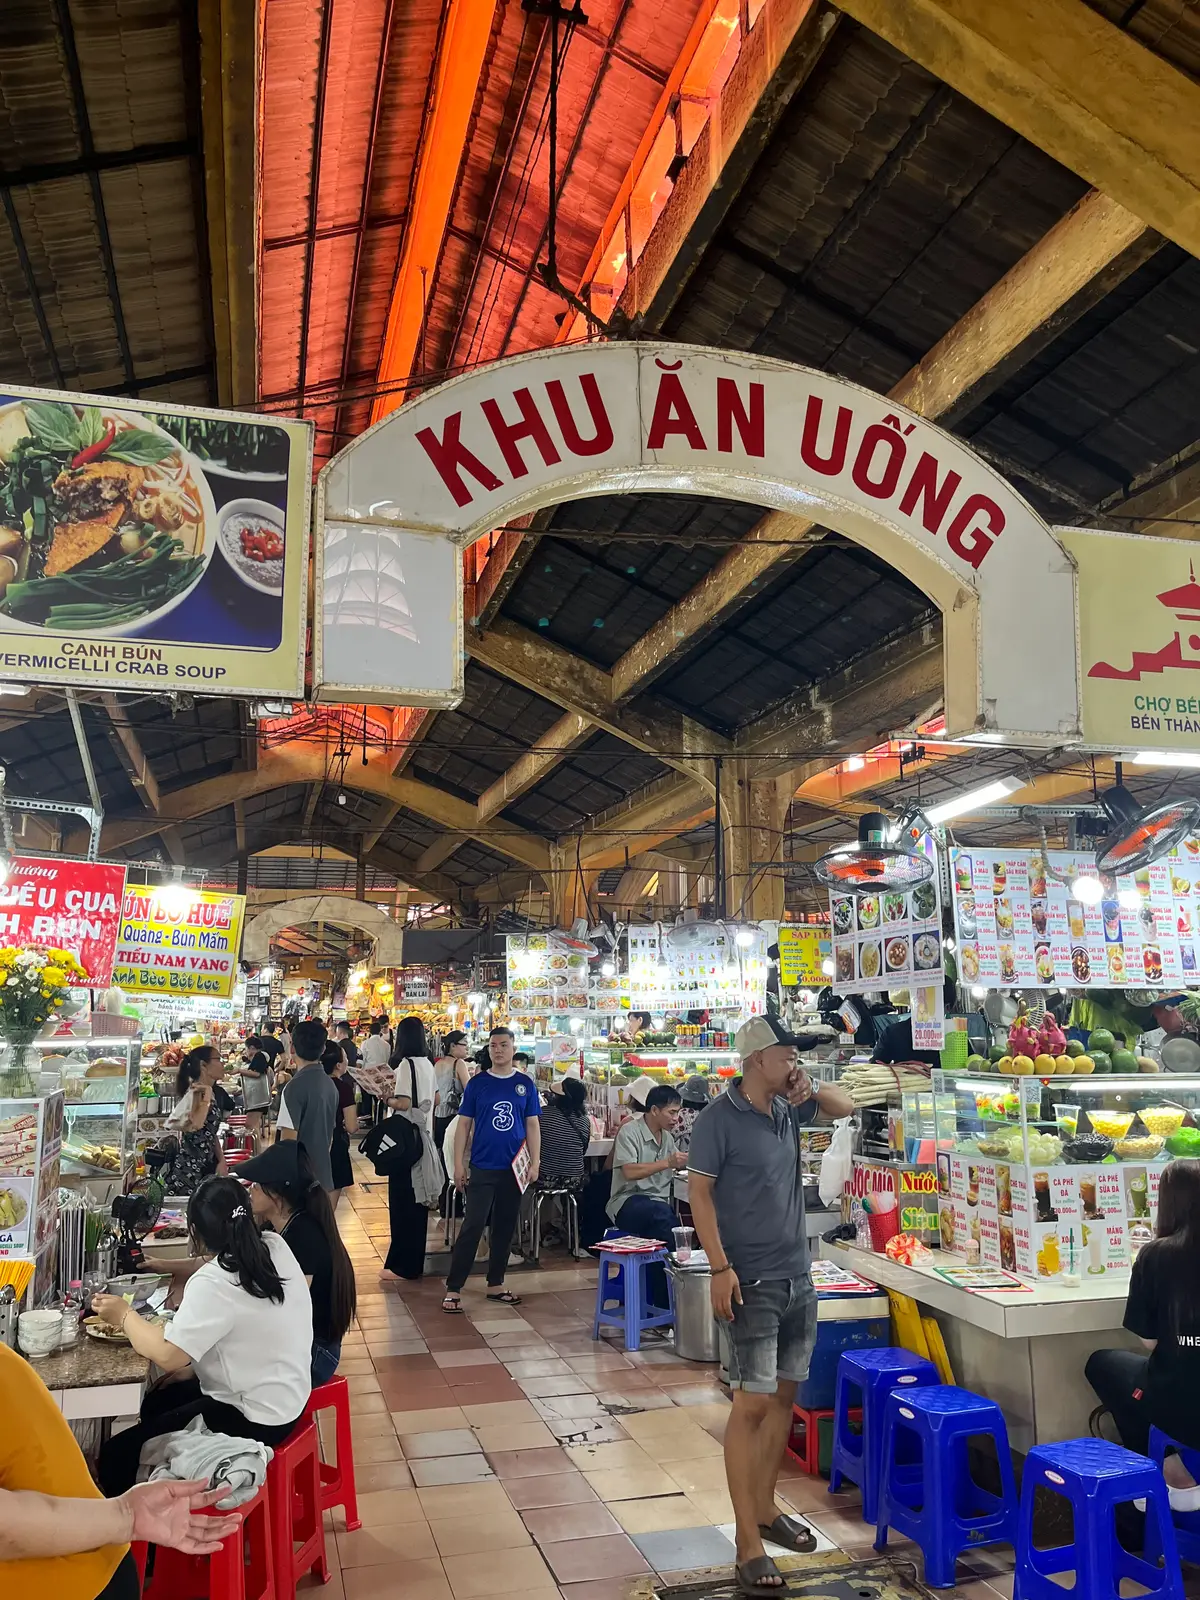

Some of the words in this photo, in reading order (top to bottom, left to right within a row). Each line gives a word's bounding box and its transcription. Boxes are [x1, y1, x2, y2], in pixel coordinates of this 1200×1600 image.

[415, 374, 613, 506] KHU
[647, 358, 765, 458] ĂN
[800, 395, 1006, 570] UỐNG
[61, 642, 116, 658] CANH
[122, 645, 162, 661] BÚN
[0, 653, 109, 672] ERMICELLI
[115, 661, 168, 676] CRAB
[175, 665, 226, 679] SOUP
[1134, 695, 1172, 715] CHỢ
[124, 891, 152, 921] ÚN
[187, 899, 234, 929] HUẾ
[123, 924, 162, 944] Quảng
[172, 929, 196, 947] Bún
[154, 954, 187, 968] NAM
[190, 957, 230, 972] VANG
[492, 1101, 515, 1131] 3
